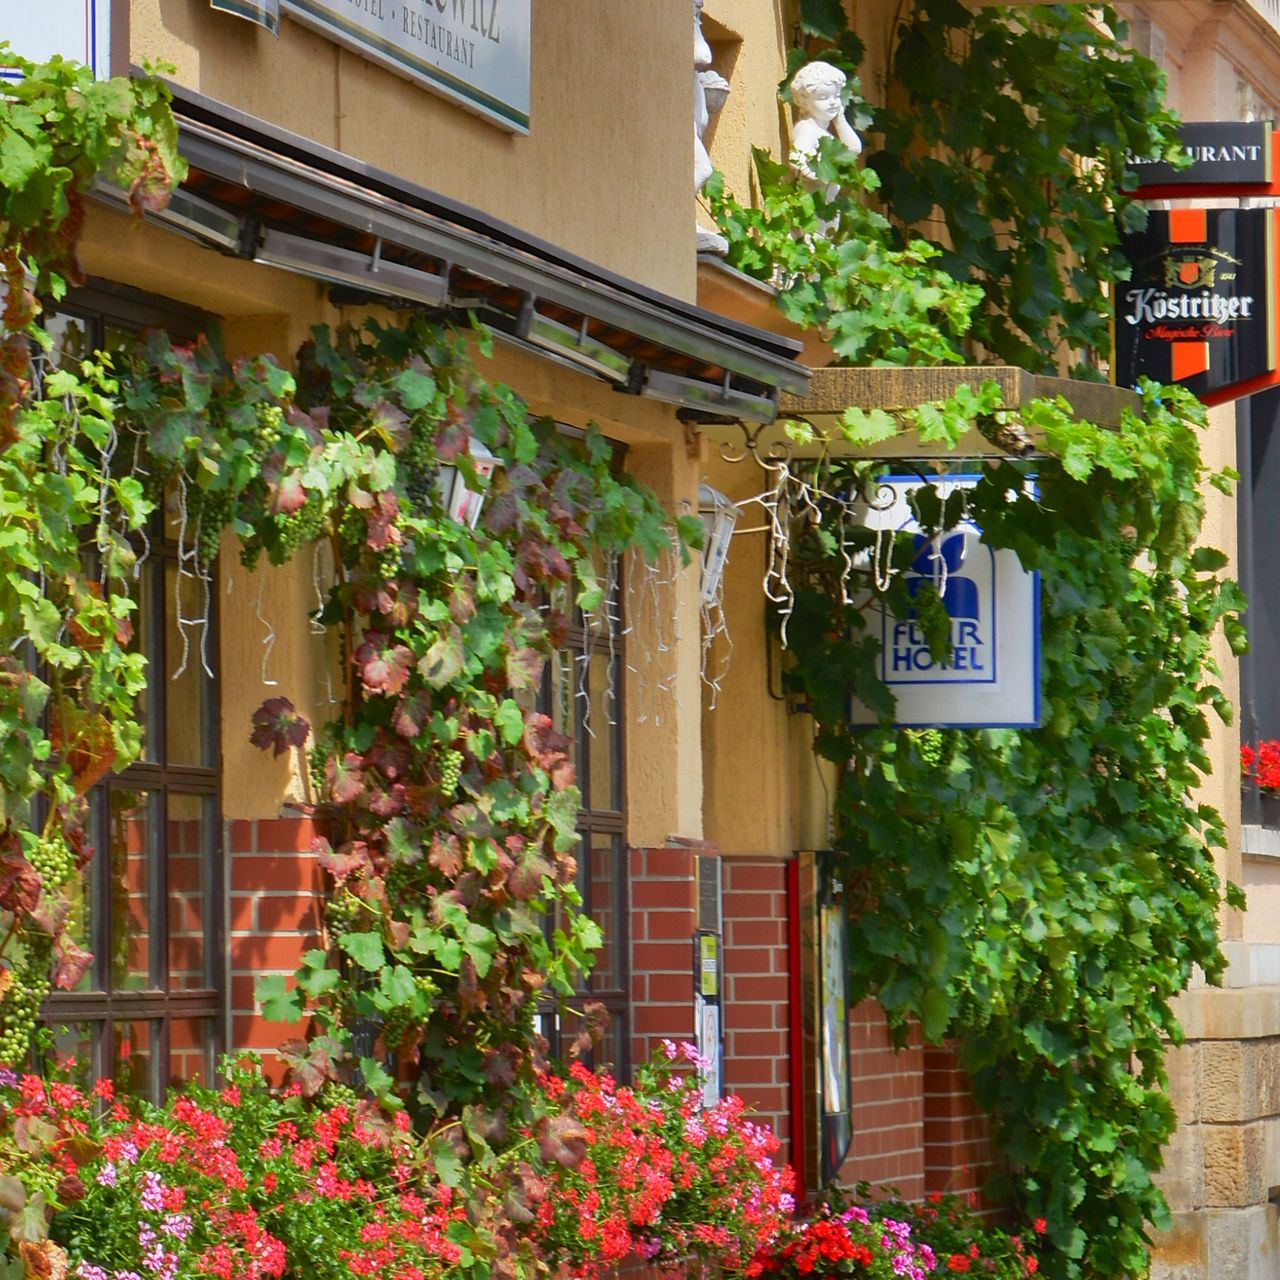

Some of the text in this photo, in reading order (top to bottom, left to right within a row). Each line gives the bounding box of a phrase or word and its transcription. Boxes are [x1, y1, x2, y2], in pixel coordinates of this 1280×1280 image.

[402, 6, 475, 69] RESTAURANT
[1124, 288, 1254, 324] Köstritzer
[893, 621, 984, 645] FLR
[893, 647, 984, 671] HOEL
